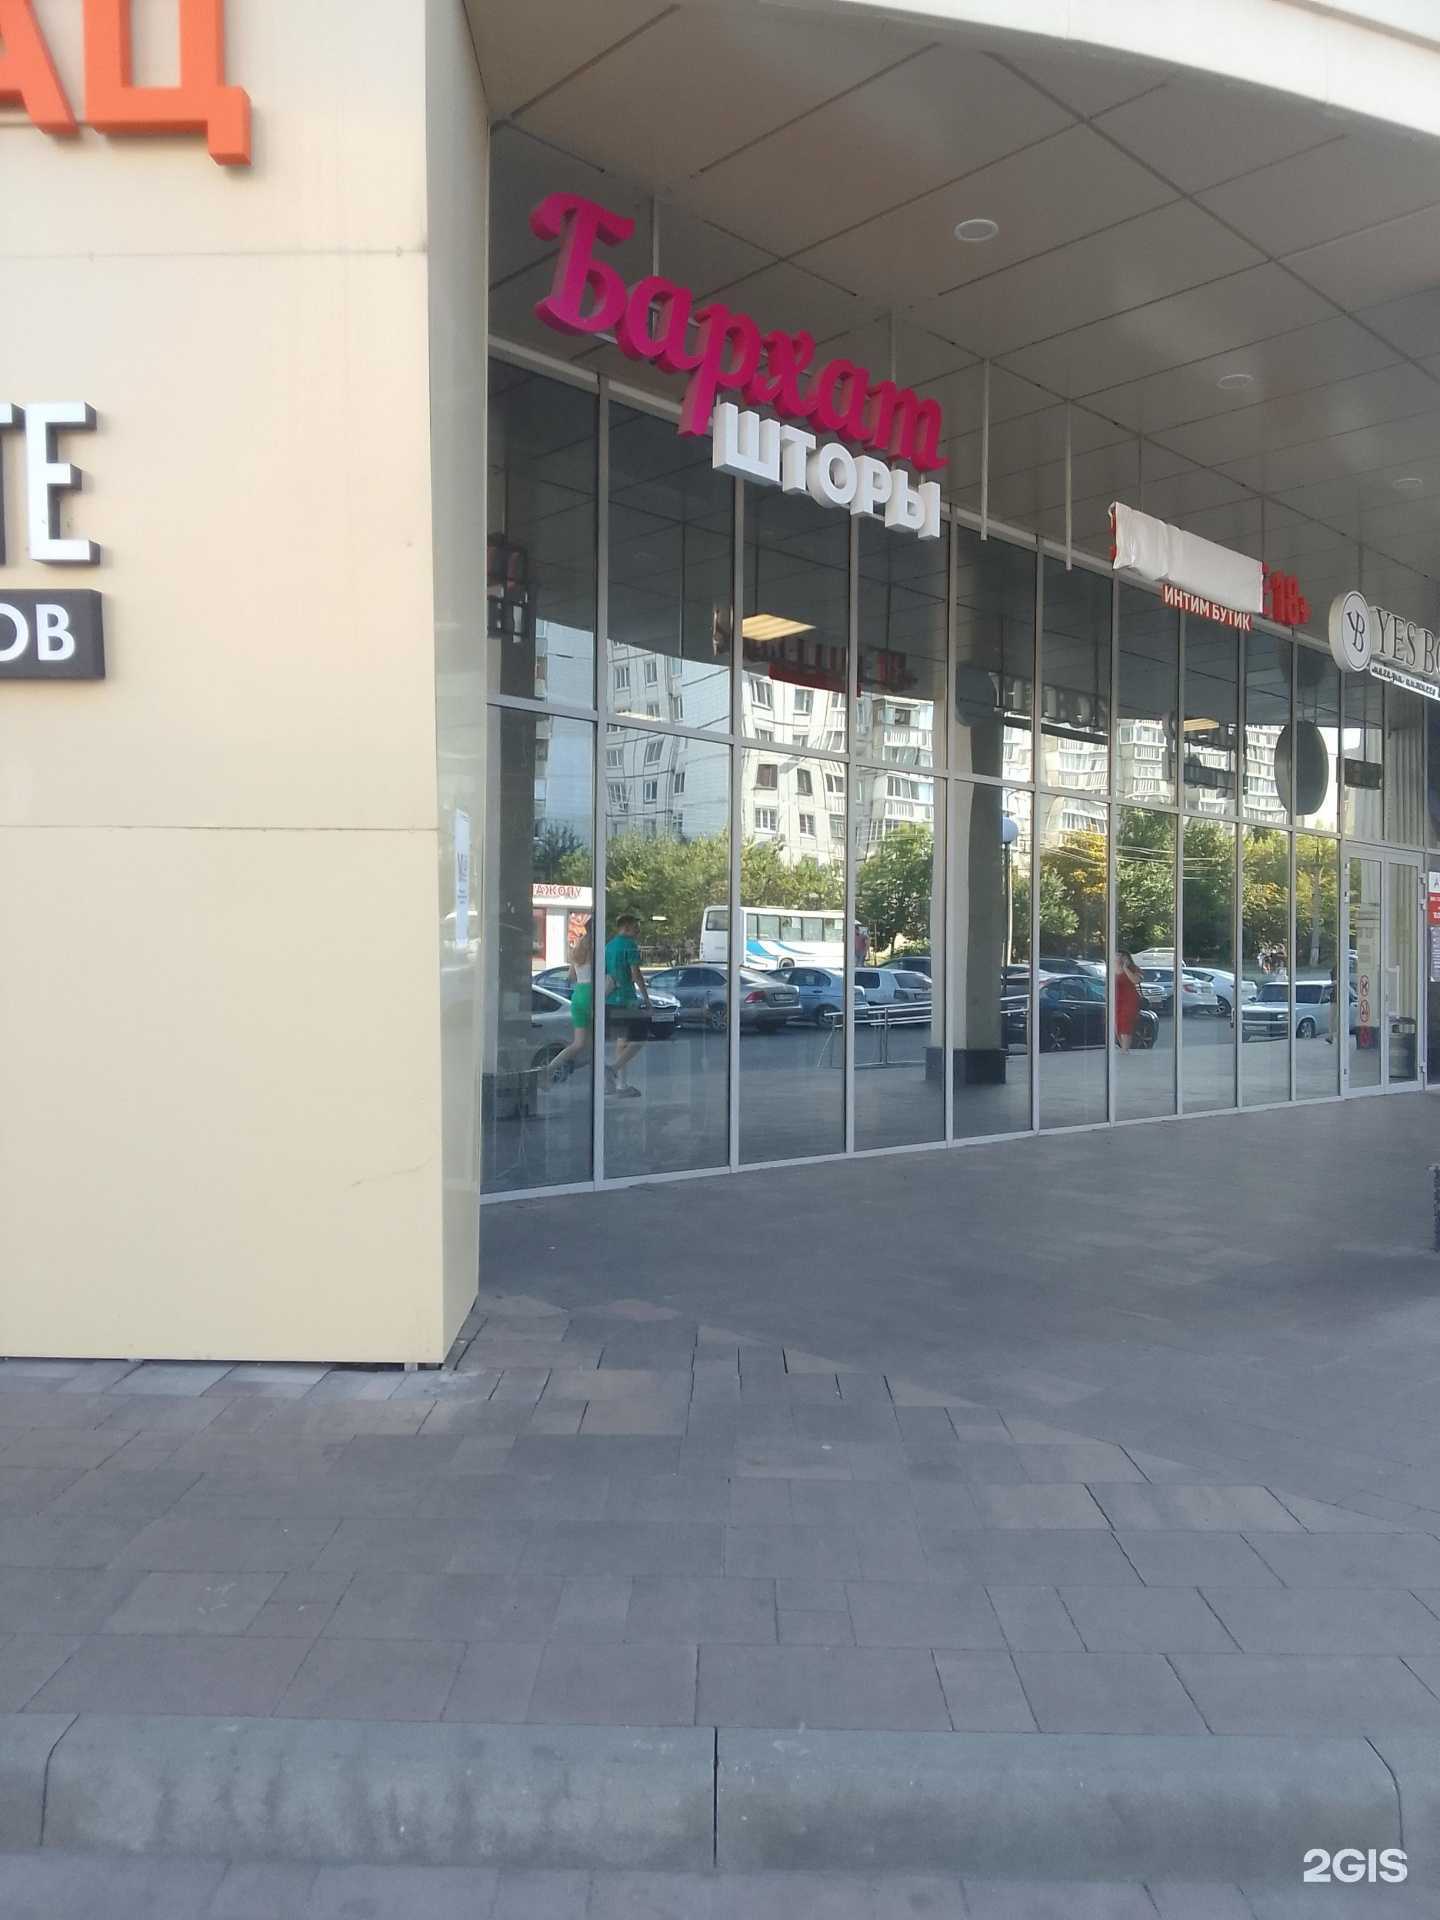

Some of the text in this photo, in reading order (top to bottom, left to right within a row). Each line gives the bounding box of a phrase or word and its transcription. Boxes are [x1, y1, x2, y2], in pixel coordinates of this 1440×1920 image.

[530, 192, 948, 471] Бархат
[0, 400, 99, 567] Е
[712, 401, 940, 540] ШТОРЫ
[1163, 584, 1251, 632] ИНТИМ БУТИК
[1375, 608, 1440, 673] YES B
